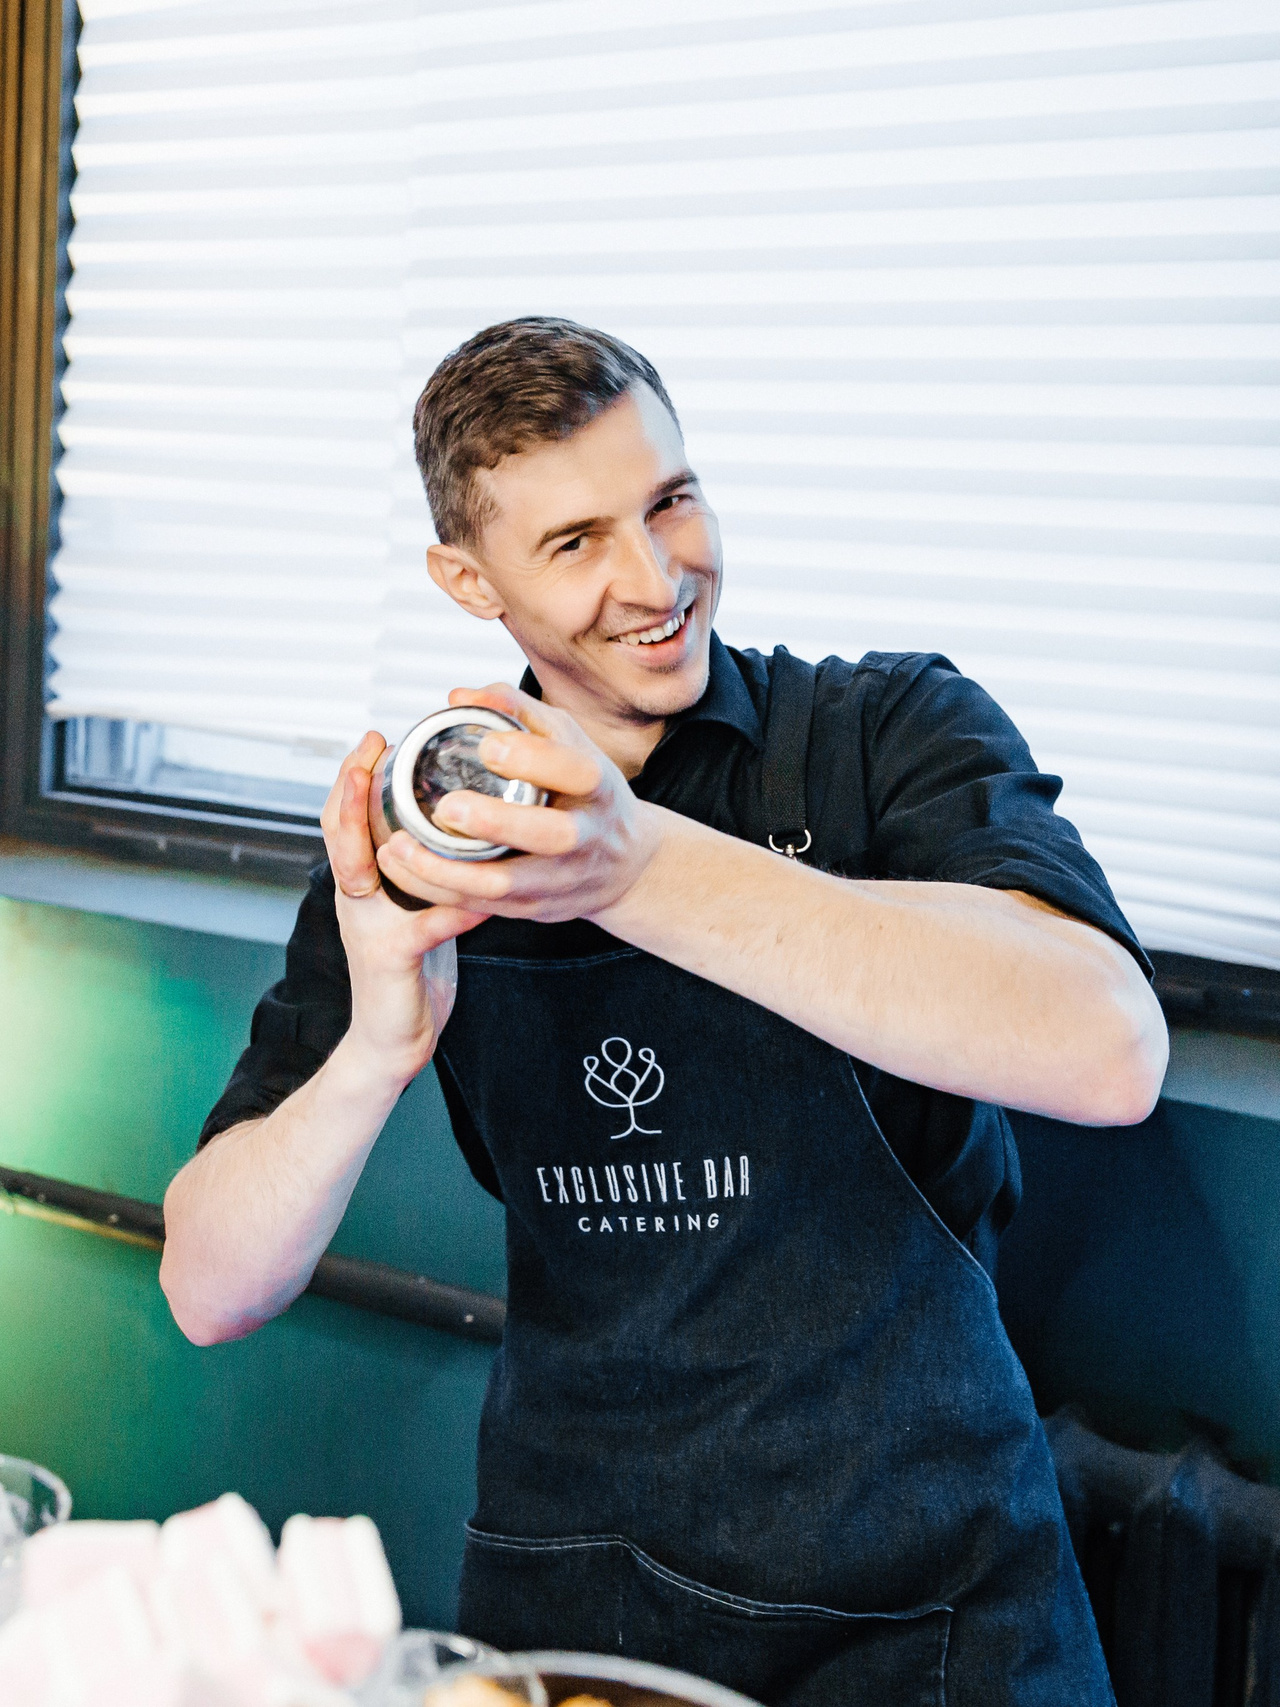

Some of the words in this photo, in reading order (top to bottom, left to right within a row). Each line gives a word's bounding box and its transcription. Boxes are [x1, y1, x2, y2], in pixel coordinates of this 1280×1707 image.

[536, 1161, 686, 1203] EXCLUSIVE
[703, 1155, 750, 1199] BAR
[577, 1213, 720, 1233] CATERING
